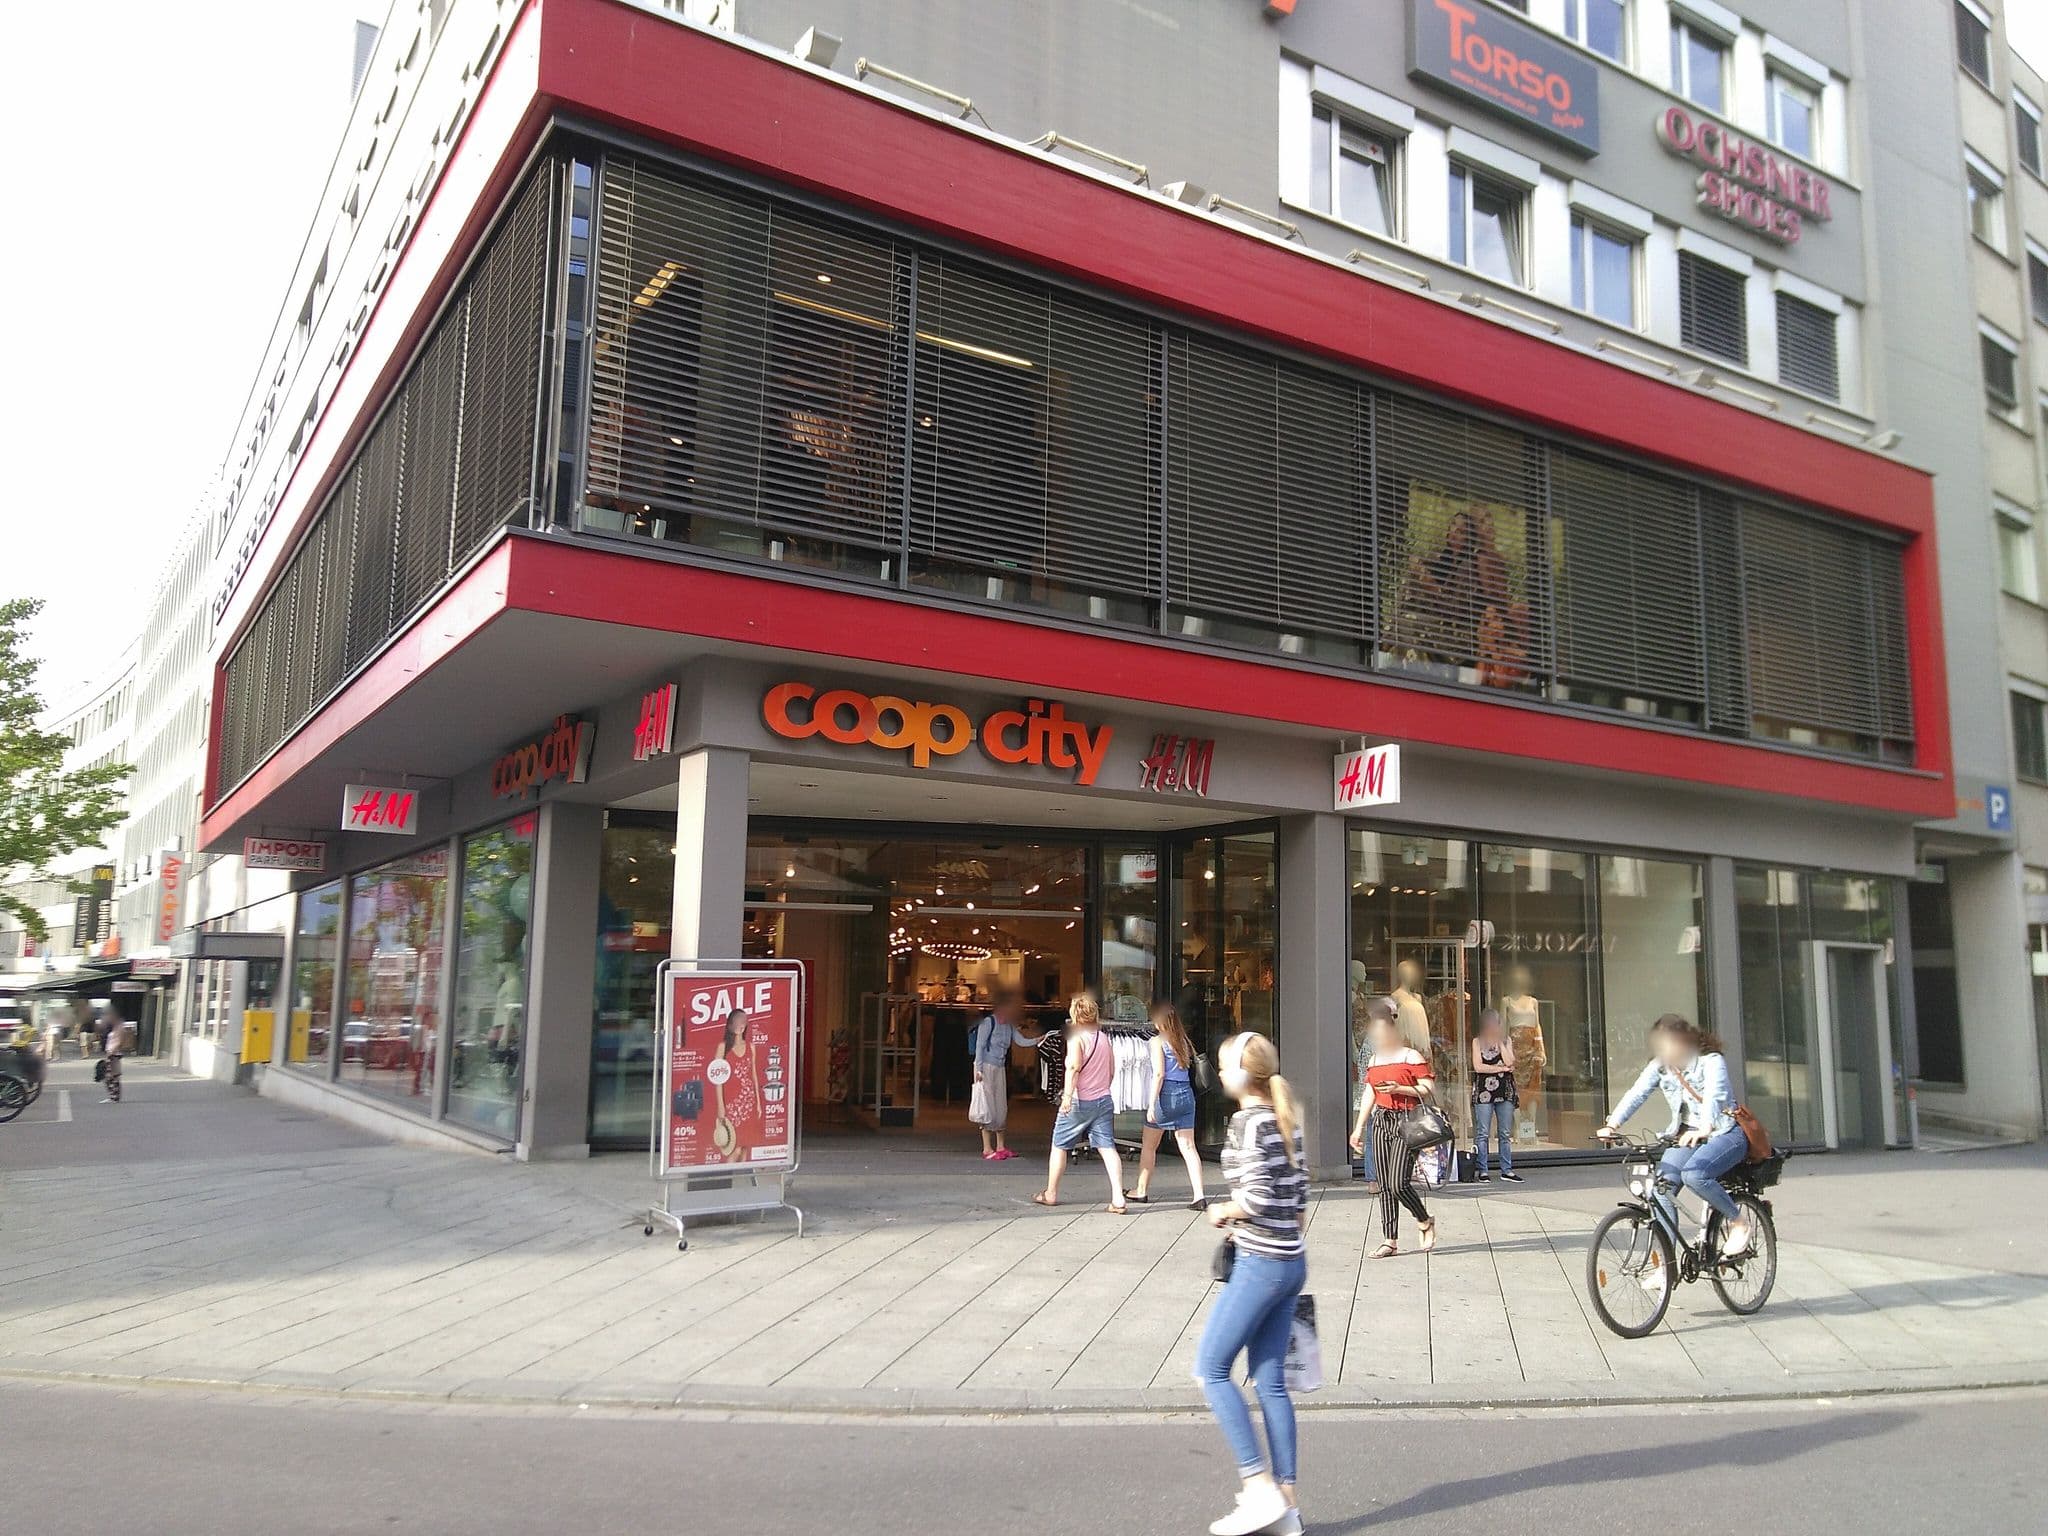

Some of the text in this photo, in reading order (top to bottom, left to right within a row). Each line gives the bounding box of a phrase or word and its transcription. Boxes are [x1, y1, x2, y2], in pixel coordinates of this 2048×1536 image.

[1434, 0, 1573, 111] TORSO
[1662, 106, 1833, 223] OCHSNER
[1700, 170, 1801, 243] SHOES
[492, 715, 590, 801] coop city
[763, 682, 1115, 787] coop city
[1139, 732, 1216, 798] H&M
[1338, 751, 1388, 803] H&M
[351, 789, 413, 830] H&M
[1990, 792, 2006, 824] P
[250, 840, 323, 858] IMPORT
[690, 981, 773, 1025] SALE
[710, 1067, 729, 1078] 50%
[673, 1126, 697, 1136] 40%
[765, 1103, 785, 1114] 50%
